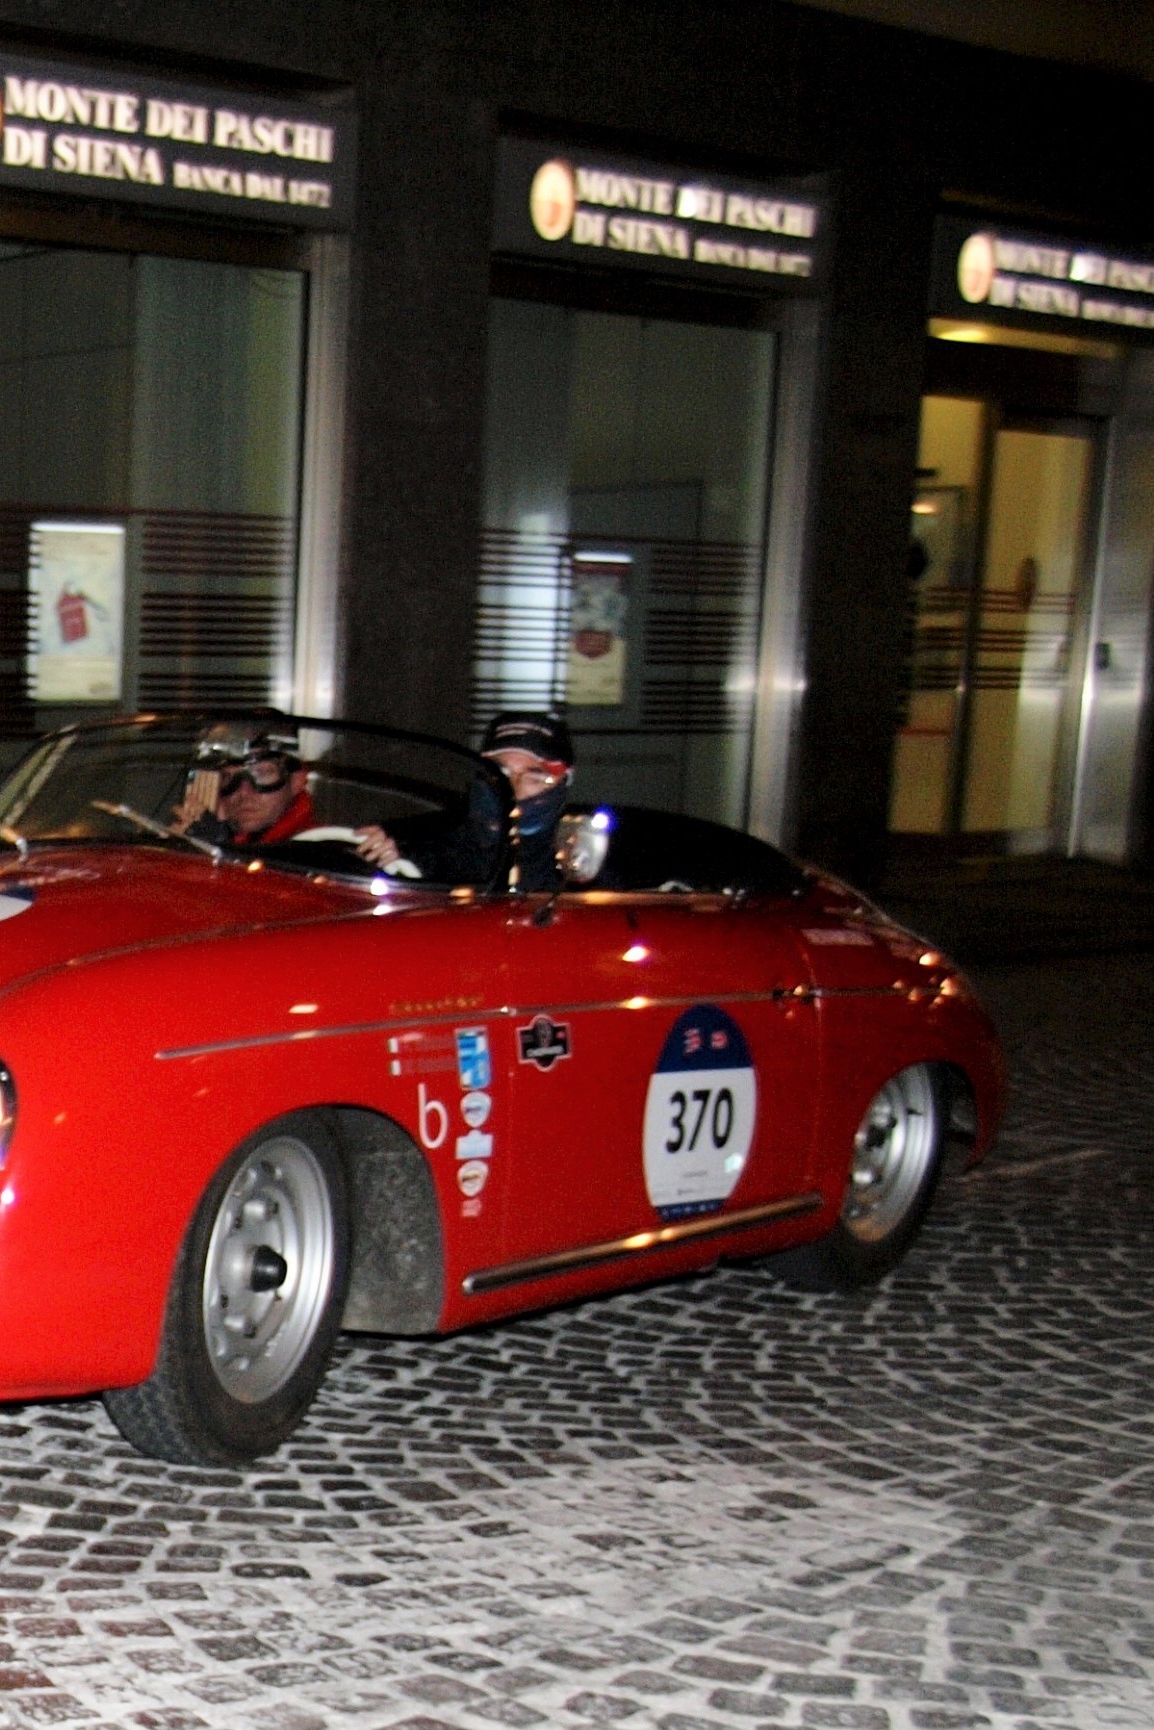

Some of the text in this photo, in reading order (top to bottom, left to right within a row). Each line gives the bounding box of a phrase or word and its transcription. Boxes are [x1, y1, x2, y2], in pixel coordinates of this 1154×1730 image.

[4, 75, 334, 163] MONTE DEI PASCHI
[3, 126, 47, 169] DI
[52, 135, 165, 186] SIENA
[571, 210, 606, 246] DI
[607, 215, 690, 260] SIENA
[575, 167, 674, 216] MONTE
[725, 191, 816, 238] PASCHI
[666, 1087, 734, 1154] 370
